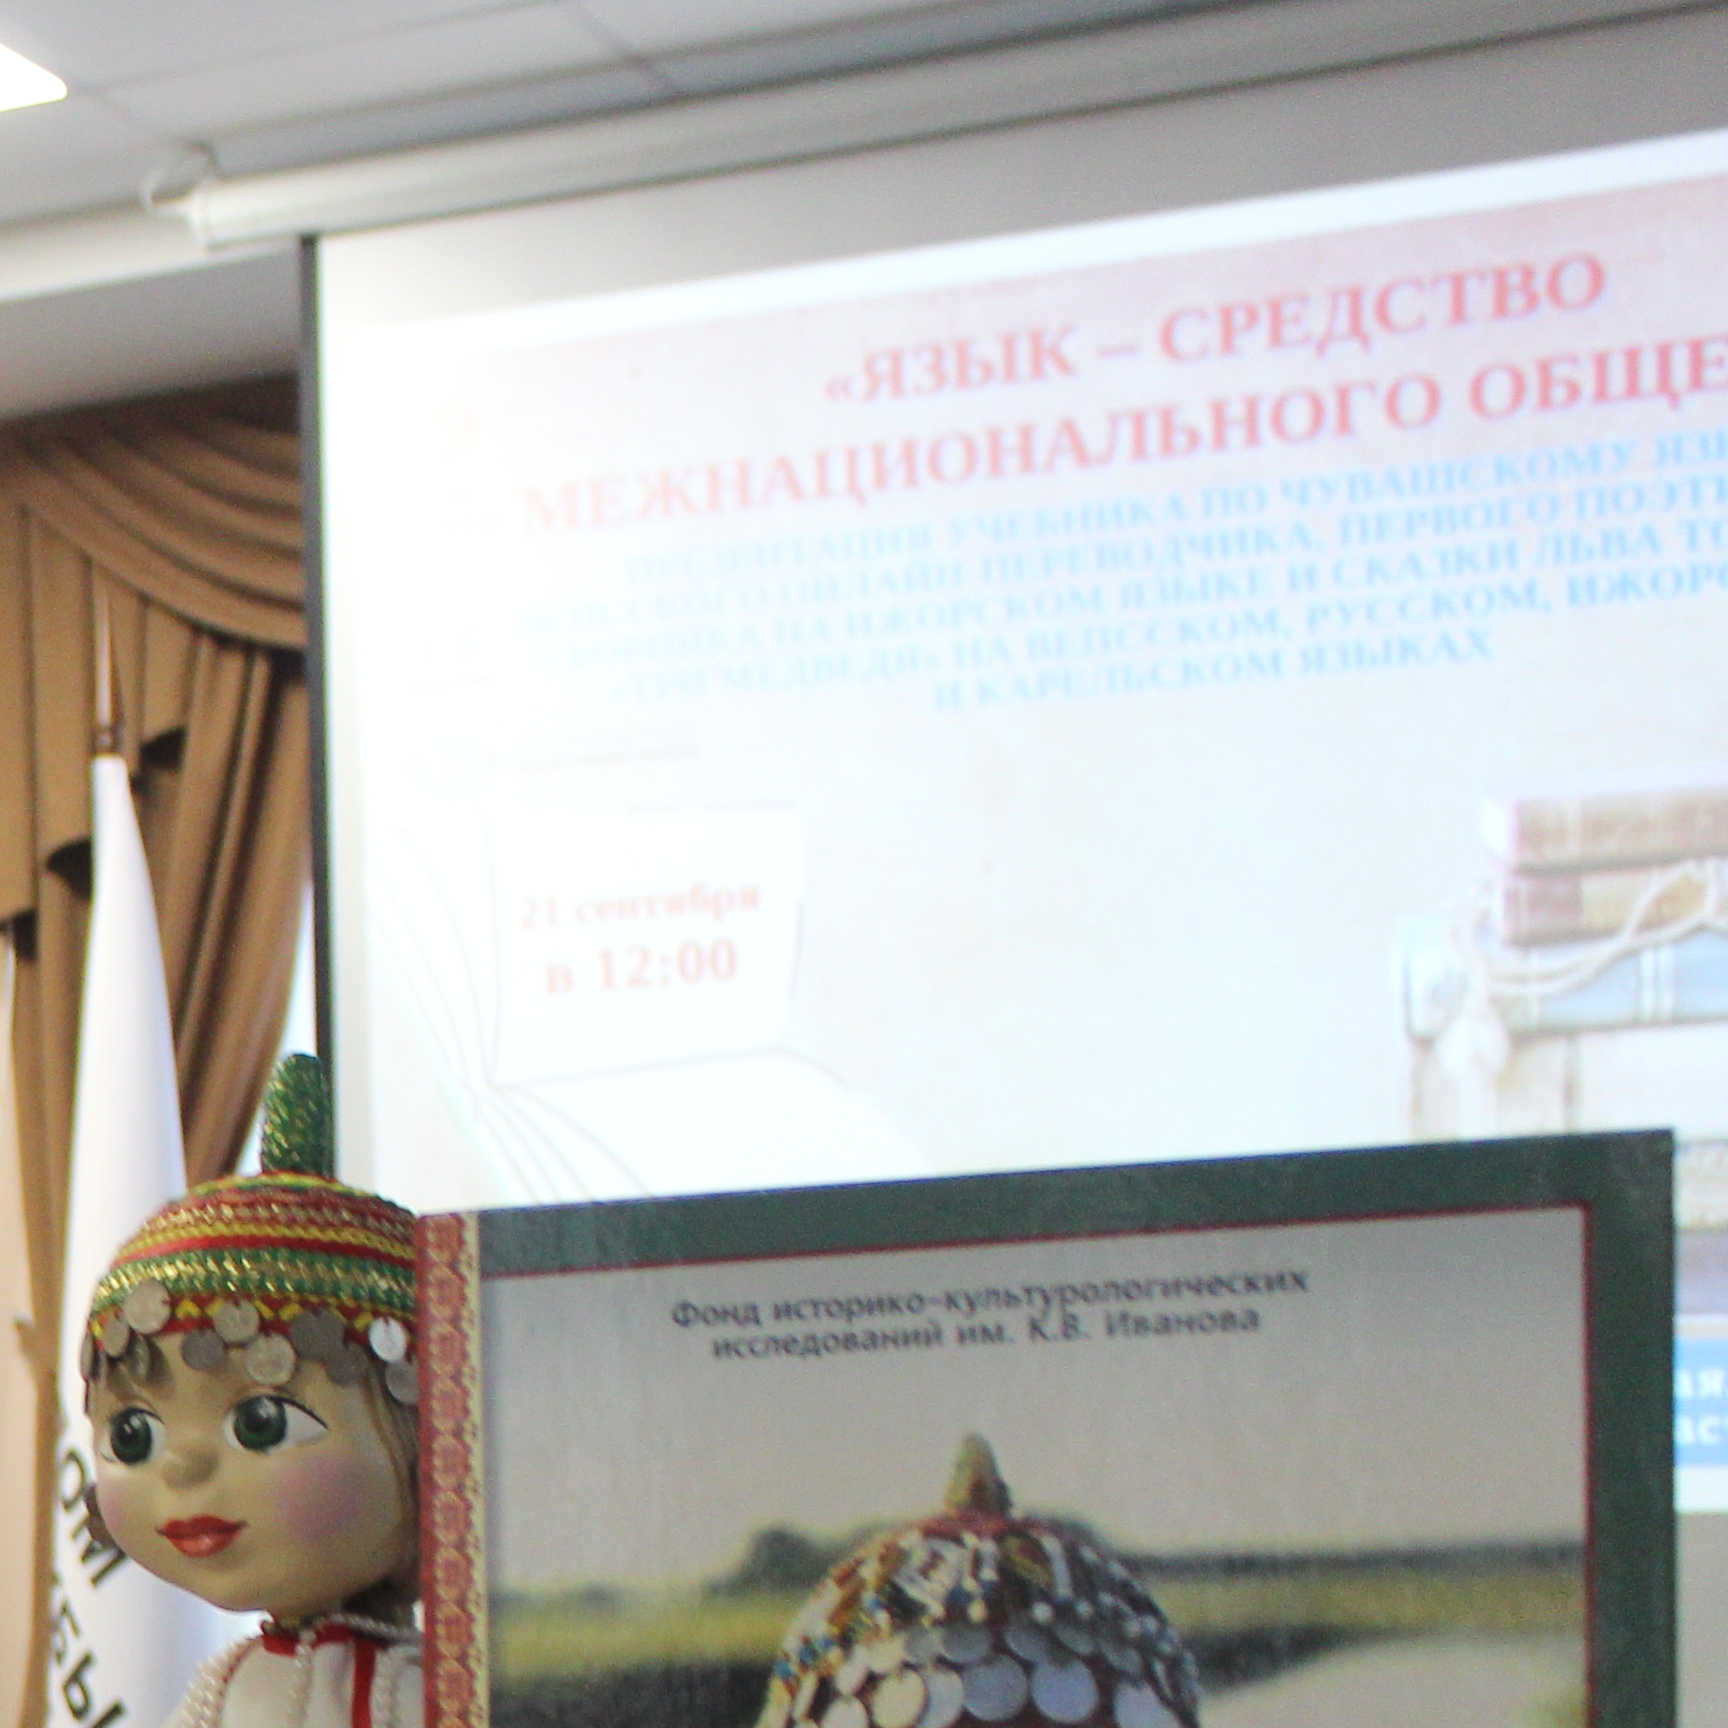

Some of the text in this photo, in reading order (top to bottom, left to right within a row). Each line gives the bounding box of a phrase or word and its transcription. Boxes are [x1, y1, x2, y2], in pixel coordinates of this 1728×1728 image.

[824, 321, 1079, 408] «ЯЗЫК
[1158, 251, 1608, 365] СРЕДСТВО
[522, 373, 1444, 537] МЕЖНАЦИОНАЛЬНОГО
[624, 526, 934, 586] ПРЕЗЕНТАЦИЯ
[946, 487, 1188, 553] УЧЕБНИКА
[1200, 482, 1268, 519] ПО
[1280, 438, 1640, 512] ЧУВАШСКОМУ
[1339, 494, 1561, 552] ПЕРВОГО
[773, 608, 834, 648] НА
[847, 578, 1103, 643] ИЖОРСКОМ
[1118, 563, 1275, 613] ЯЗЫКЕ
[1286, 559, 1318, 595] И
[1331, 534, 1520, 591] СКАЗКИ
[1531, 519, 1663, 570] ЛЬВА
[952, 635, 1014, 671] НА
[1305, 578, 1551, 636] РУССКОМ,
[931, 625, 1497, 714] И КАРЕЛЬСКОМ ЯЗЫКАХ
[519, 879, 762, 932] 21 сентября
[543, 936, 741, 997] в 12:00
[670, 1269, 1307, 1328] Фонд историко-культурологических
[712, 1307, 1261, 1359] исследований им. К.В. Иванова
